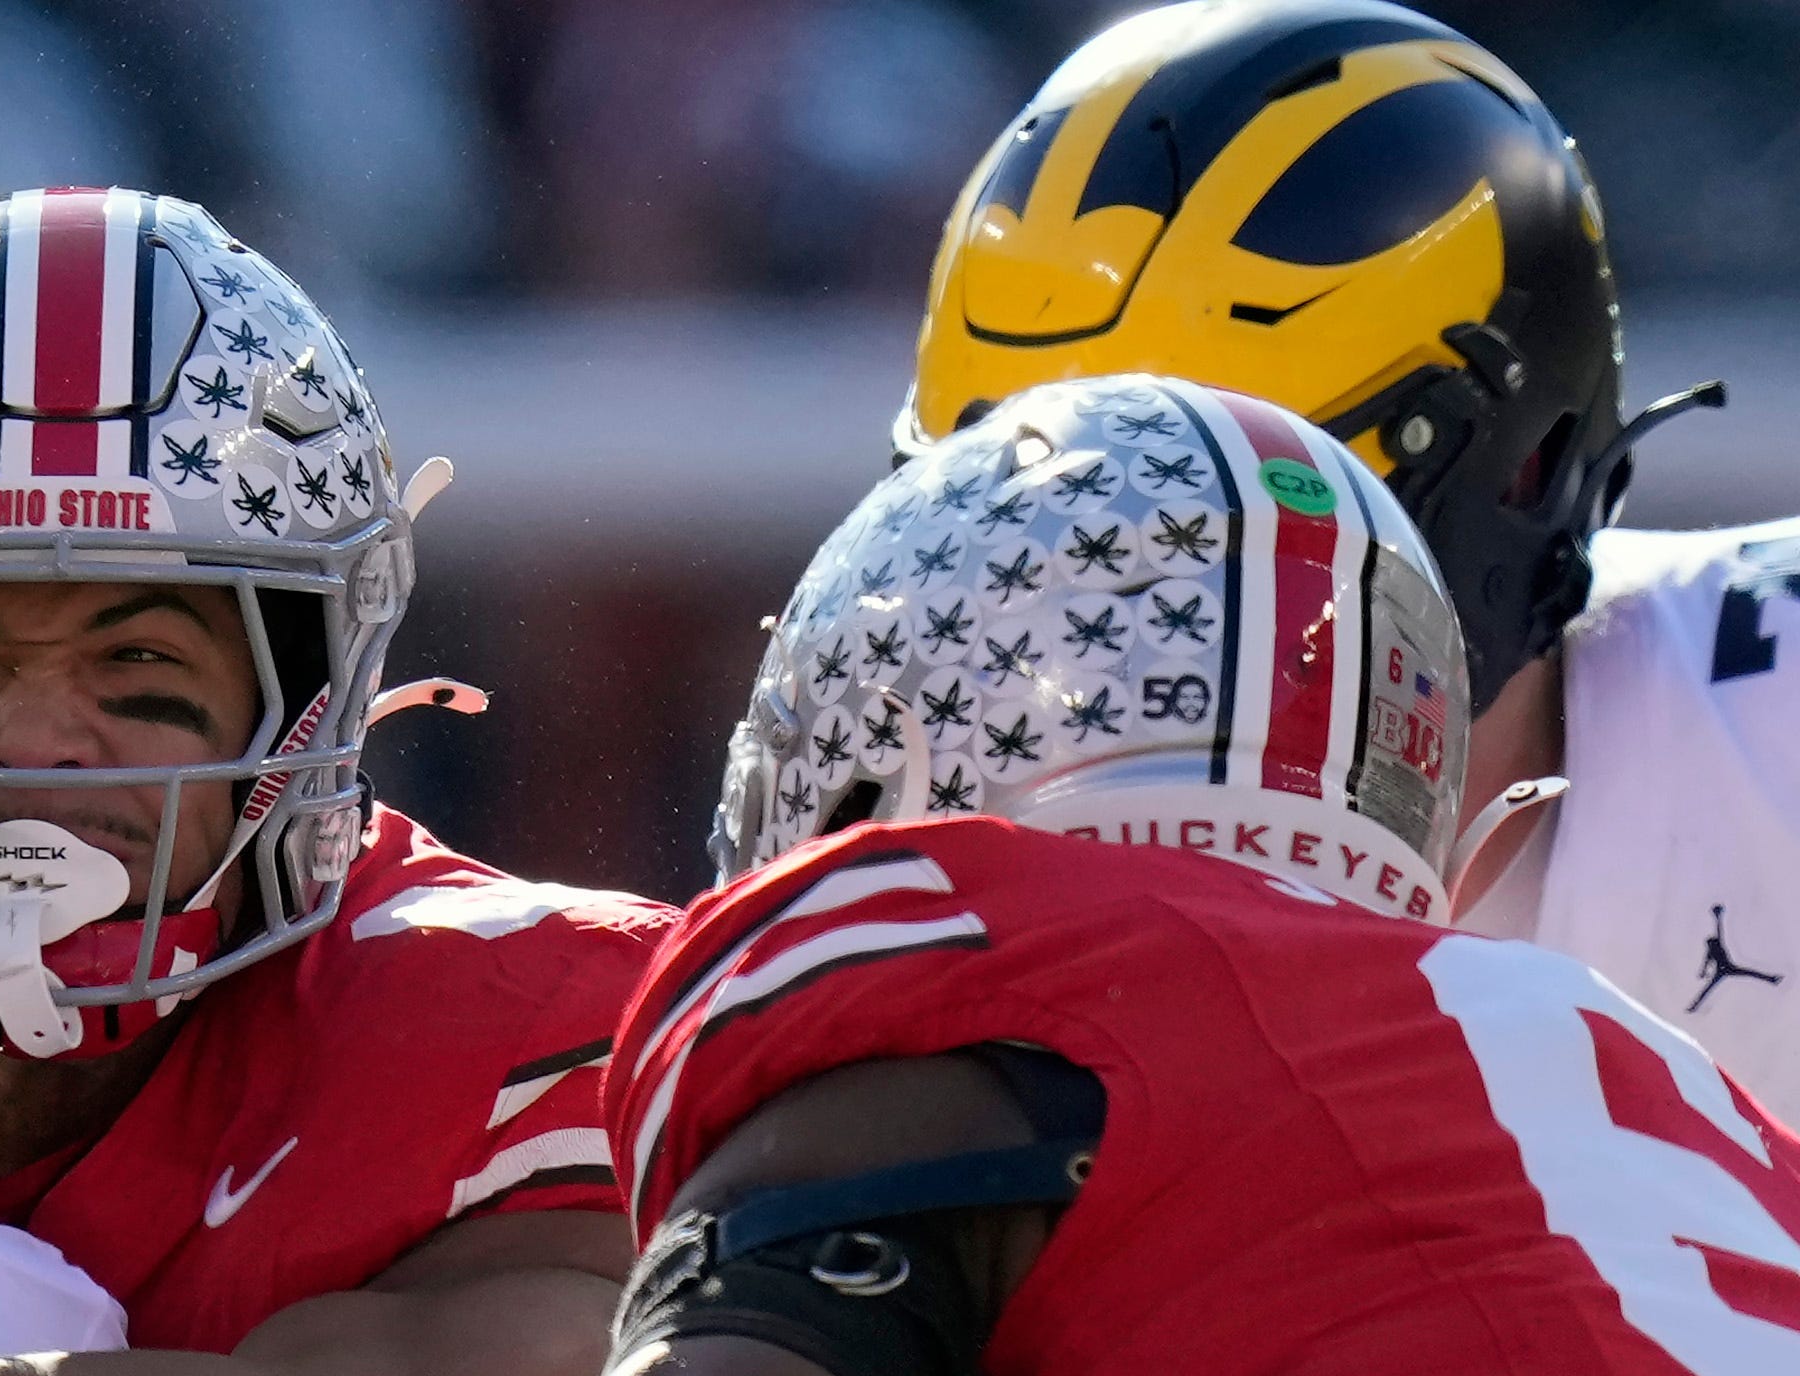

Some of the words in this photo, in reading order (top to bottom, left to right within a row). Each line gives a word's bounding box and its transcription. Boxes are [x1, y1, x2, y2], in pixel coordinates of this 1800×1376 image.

[1267, 471, 1329, 498] C2P
[58, 489, 151, 530] STATE
[1388, 647, 1403, 684] 6
[1142, 674, 1211, 725] 50
